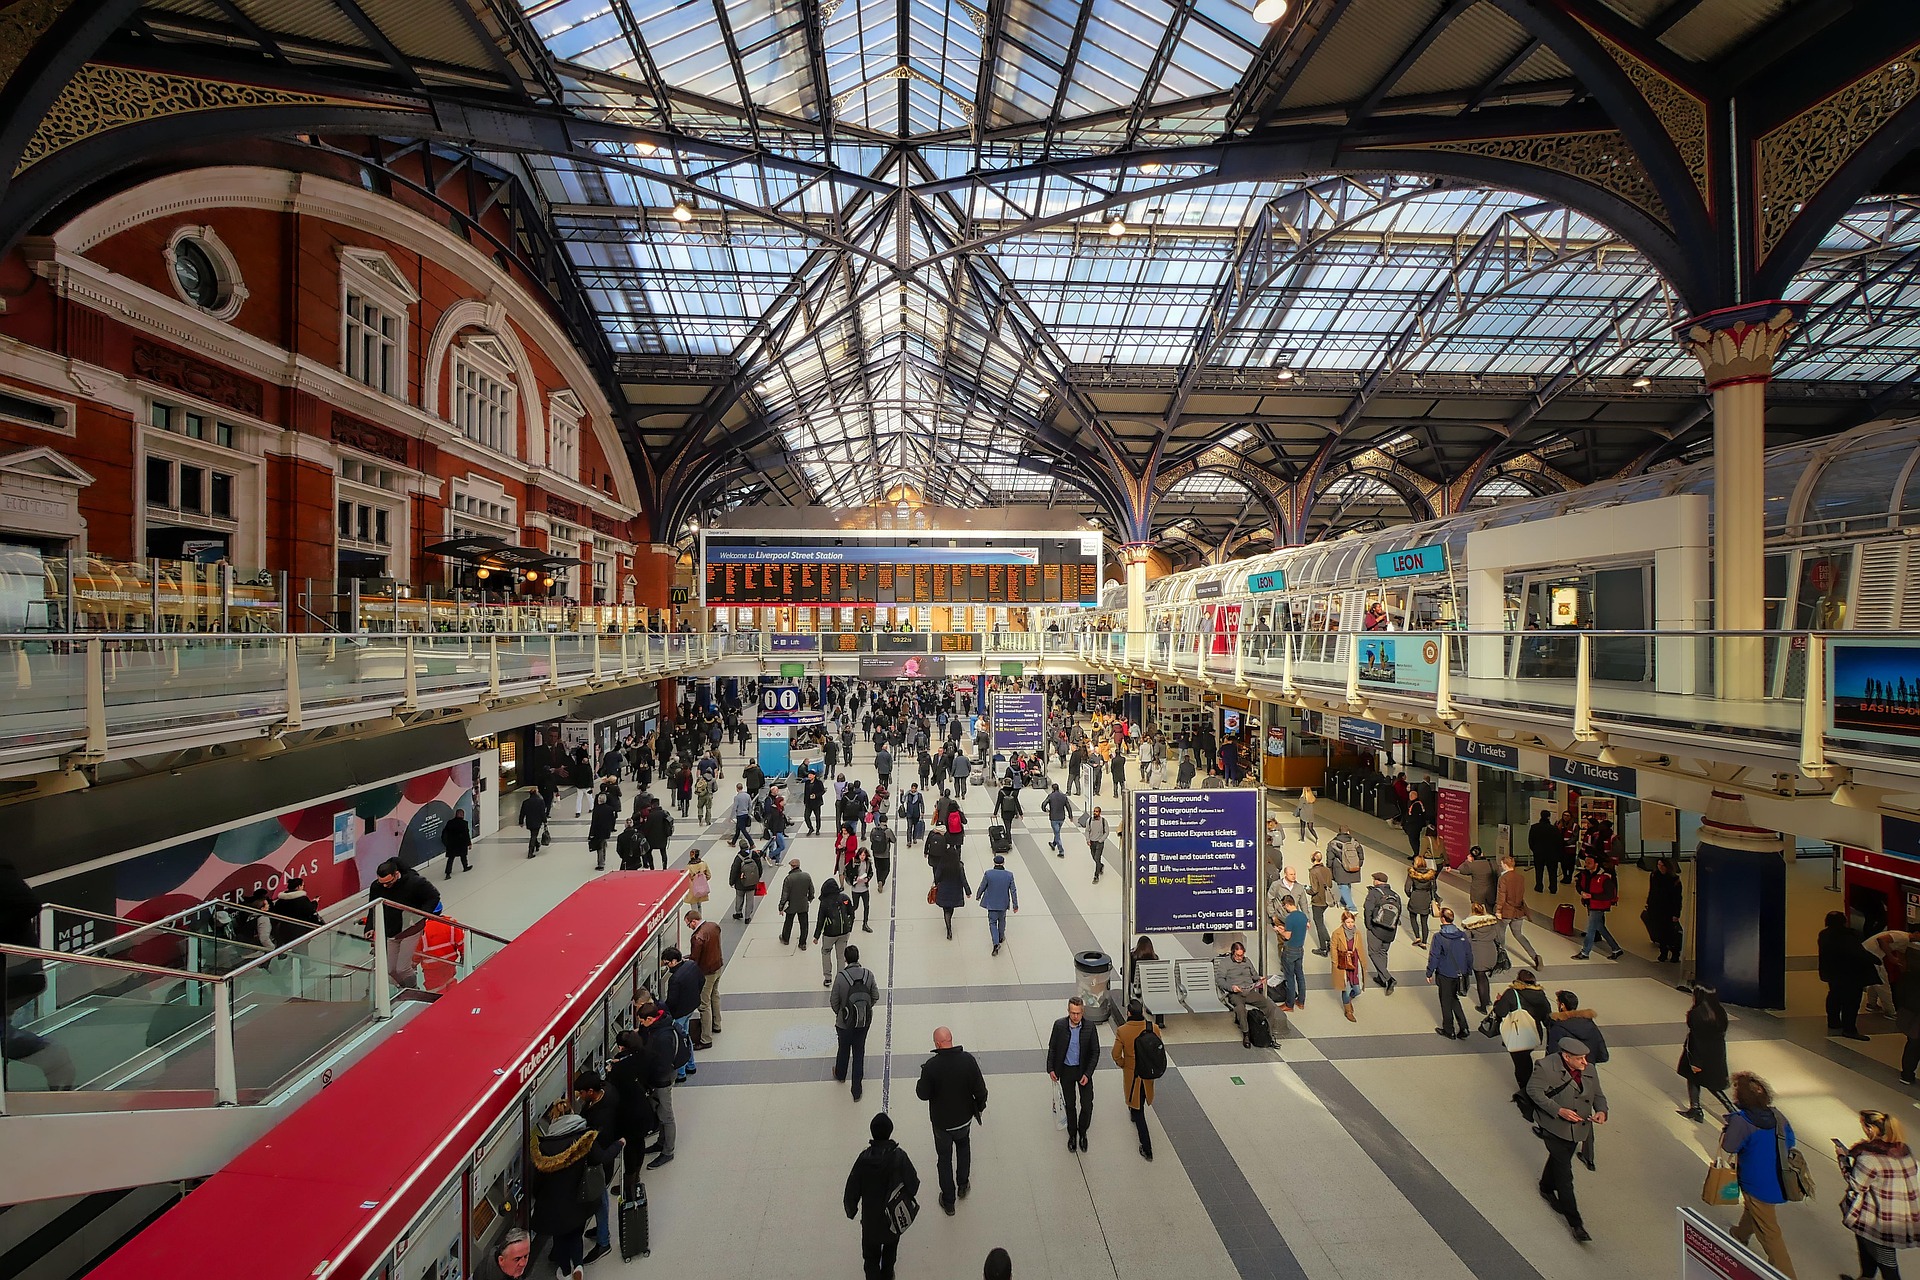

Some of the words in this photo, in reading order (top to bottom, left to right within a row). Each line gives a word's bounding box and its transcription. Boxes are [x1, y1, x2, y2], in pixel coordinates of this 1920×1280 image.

[4, 496, 65, 516] HOTEL
[756, 552, 790, 560] Liverpool
[1393, 553, 1424, 572] LEON
[1257, 576, 1274, 588] LEON
[82, 590, 110, 600] ESPRESSO
[1301, 709, 1309, 720] 10
[1860, 703, 1920, 715] BASILDO
[1479, 744, 1506, 758] Tickets
[1581, 764, 1619, 782] Tickets
[1160, 794, 1202, 803] Underground
[1160, 807, 1198, 815] Overground
[646, 916, 661, 934] Tickets
[518, 1046, 550, 1084] Tickets
[1686, 1225, 1712, 1249] Planned
[1714, 1246, 1738, 1268] service
[1686, 1233, 1720, 1262] alterations
